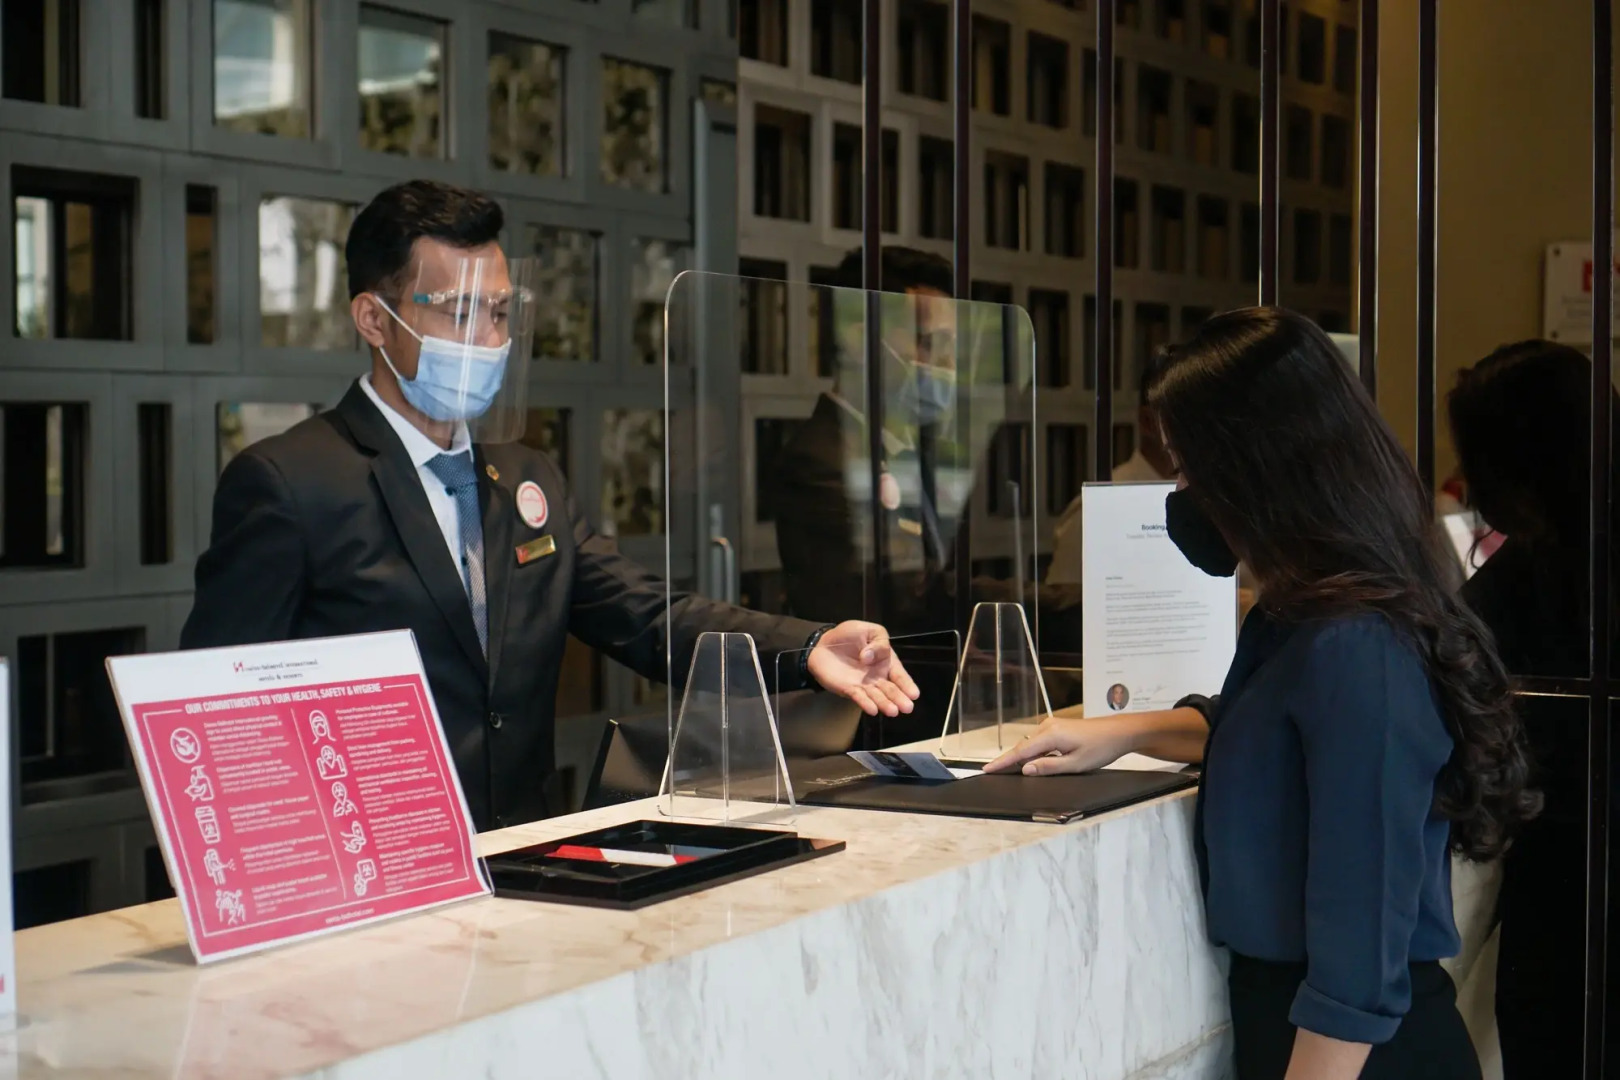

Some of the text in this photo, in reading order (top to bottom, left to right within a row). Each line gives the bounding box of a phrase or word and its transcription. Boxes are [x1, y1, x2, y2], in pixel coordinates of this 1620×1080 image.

[185, 684, 382, 714] OUR COMMITMENTS TO YOUR HEALTH, SAFETY & HYGIENE
